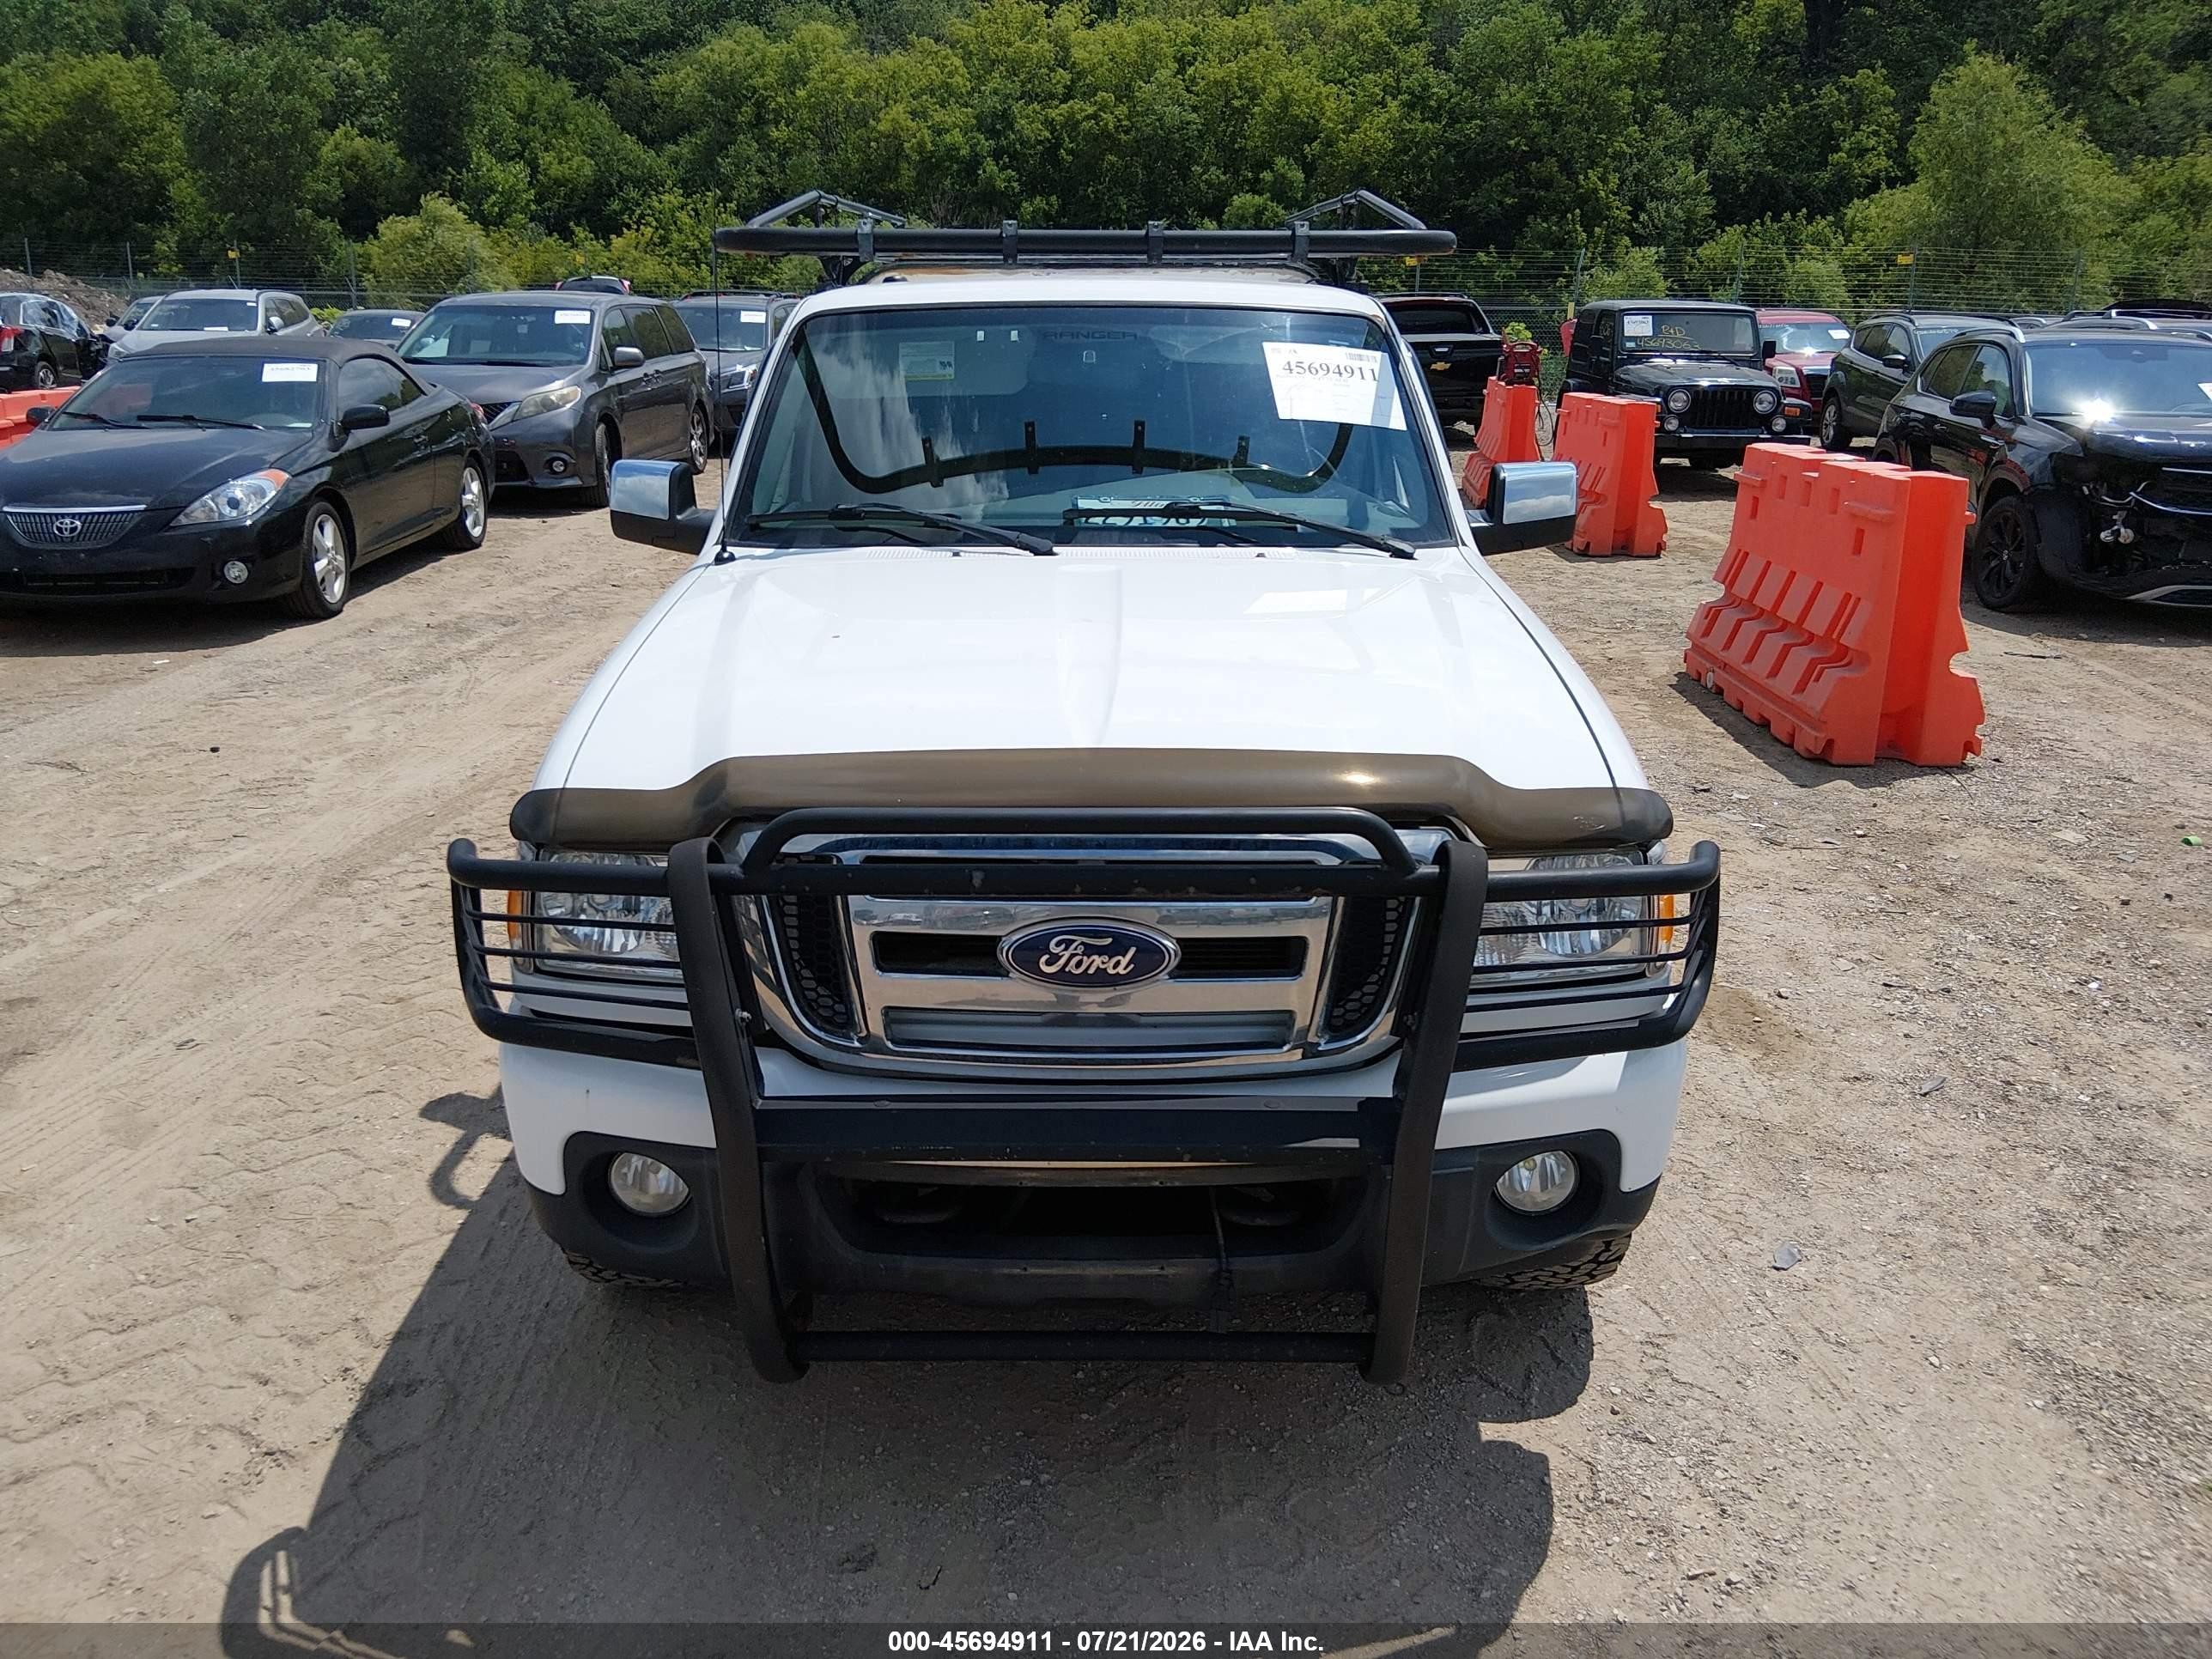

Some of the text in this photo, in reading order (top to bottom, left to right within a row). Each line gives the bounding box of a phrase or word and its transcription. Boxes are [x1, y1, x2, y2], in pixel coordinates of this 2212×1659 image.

[1043, 331, 1138, 340] RANGER
[1282, 360, 1380, 382] 45694911
[1039, 934, 1137, 975] Ford
